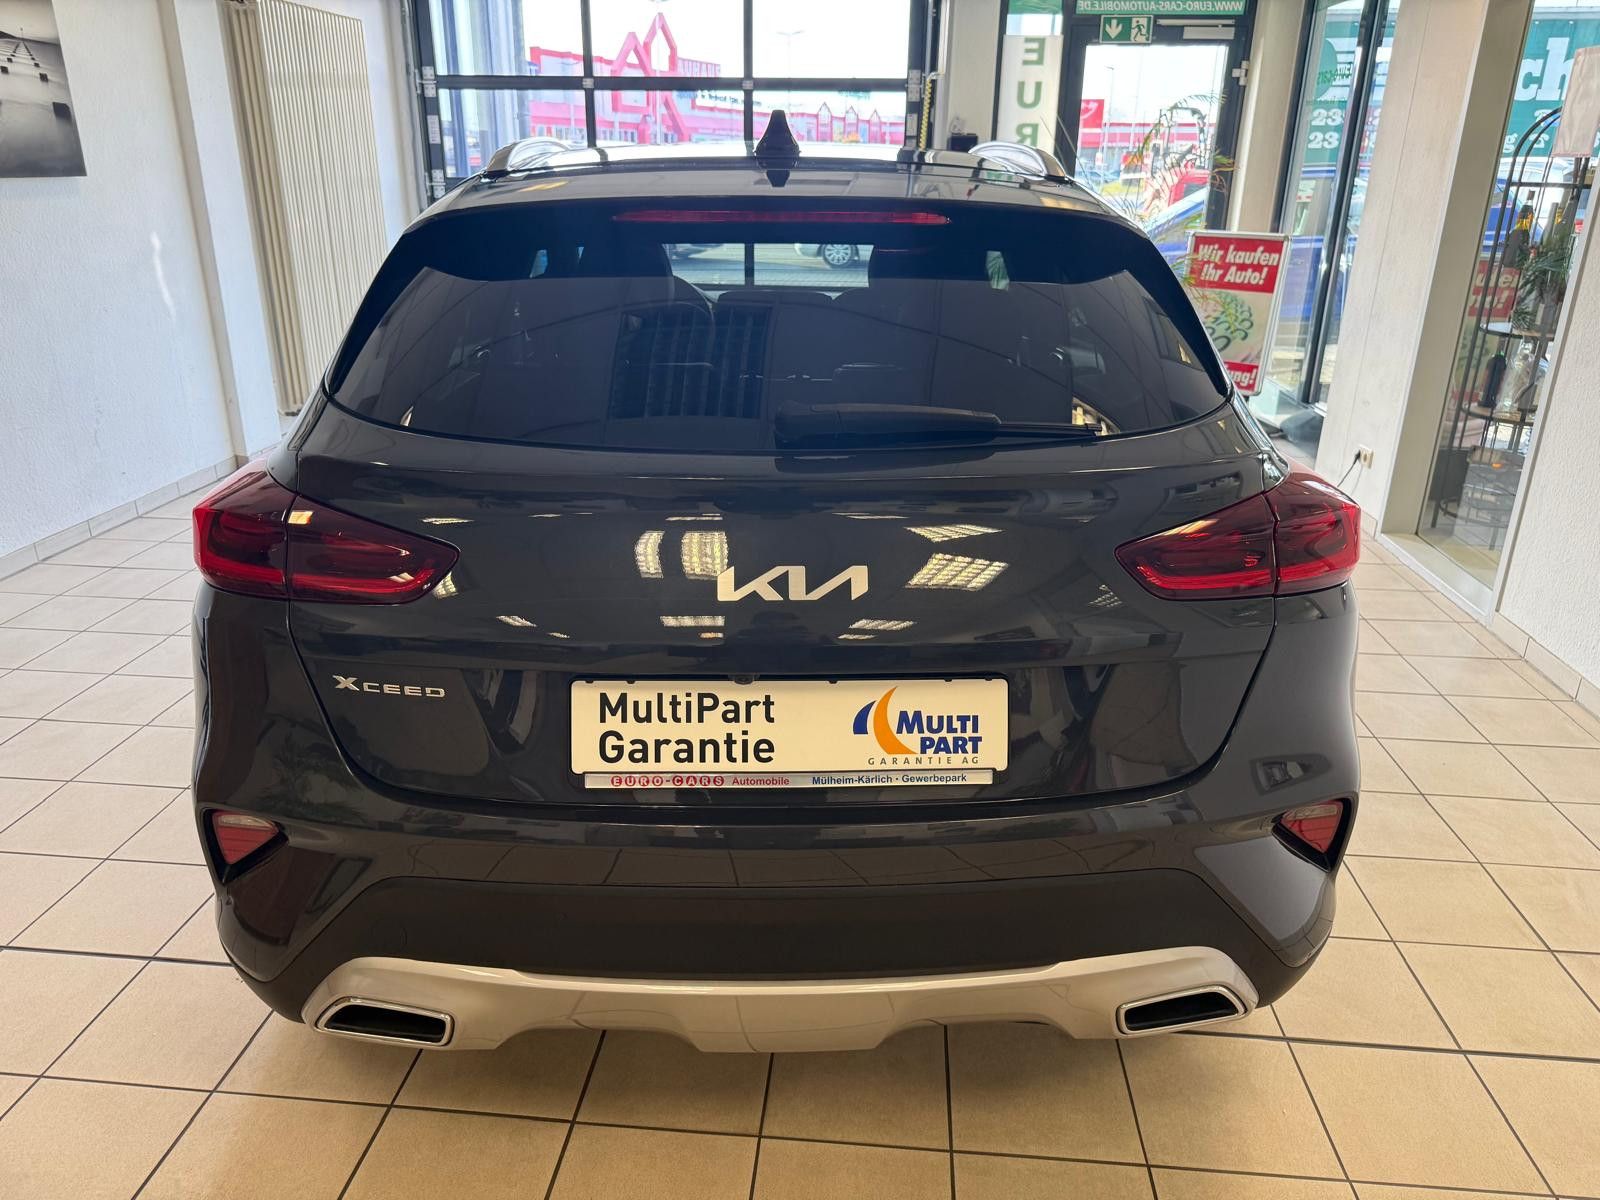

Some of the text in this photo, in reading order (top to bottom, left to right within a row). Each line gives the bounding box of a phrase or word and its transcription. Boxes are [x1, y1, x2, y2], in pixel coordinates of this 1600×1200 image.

[1311, 108, 1345, 126] 23
[1197, 244, 1280, 266] Wir kaufen
[1200, 263, 1268, 285] Ihr Auto!
[1226, 365, 1257, 387] ung!
[717, 565, 868, 602] KIA
[332, 675, 446, 698] XCEED
[600, 692, 775, 724] MultiPart
[896, 710, 979, 735] MULTI
[599, 730, 775, 764] Garantie
[919, 736, 982, 755] PART
[867, 756, 979, 766] GARANTIE AG
[610, 774, 790, 788] EURO-CARS Automobile
[812, 773, 967, 786] Mülheim-Kärlich Gewerbepark
